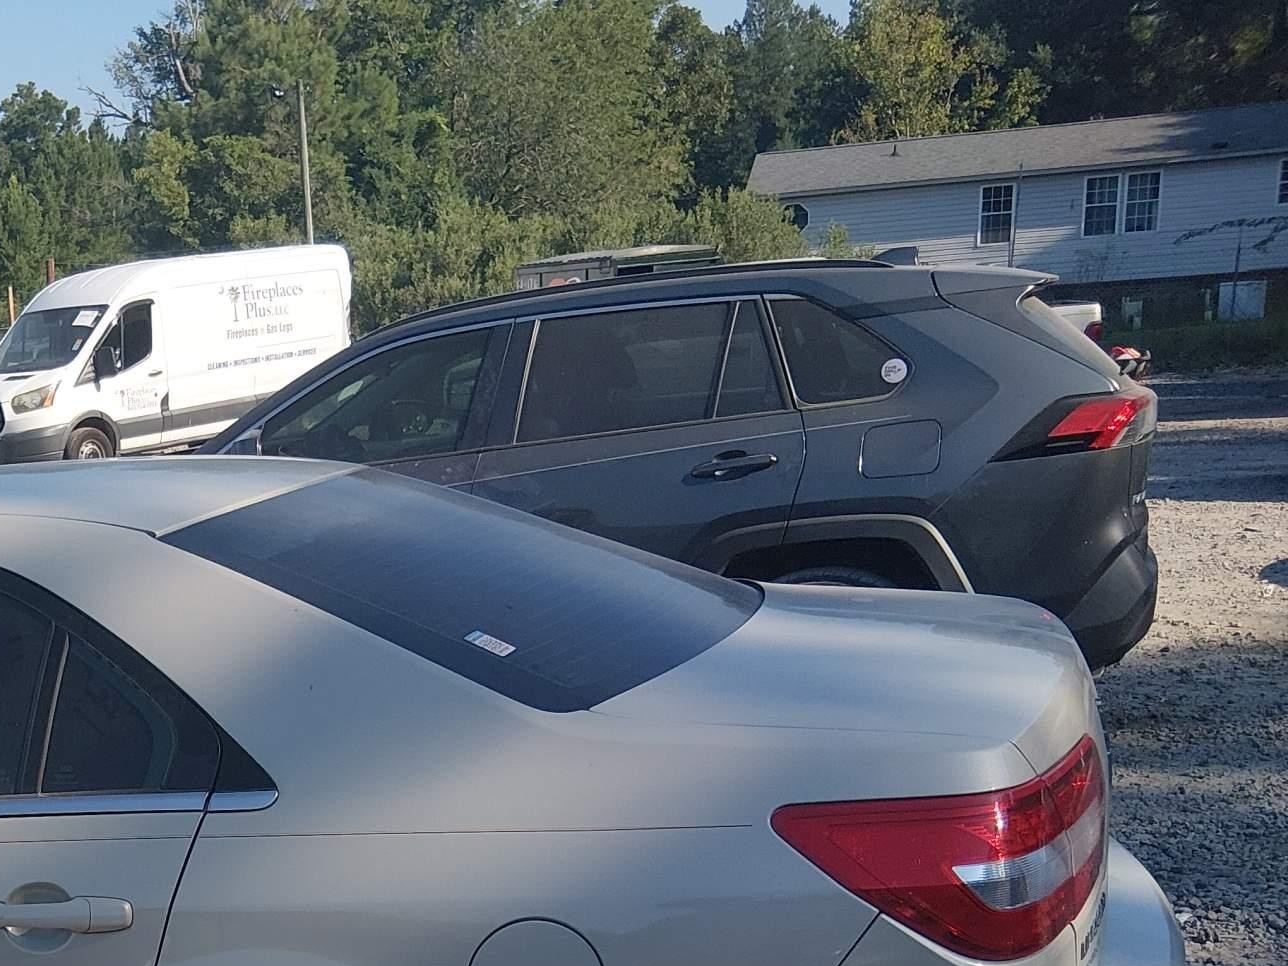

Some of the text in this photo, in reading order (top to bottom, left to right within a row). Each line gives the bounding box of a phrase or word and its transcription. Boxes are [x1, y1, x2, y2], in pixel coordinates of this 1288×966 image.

[242, 281, 304, 302] Fireplaces
[226, 328, 259, 341] Fireplaces
[279, 322, 294, 335] Logs
